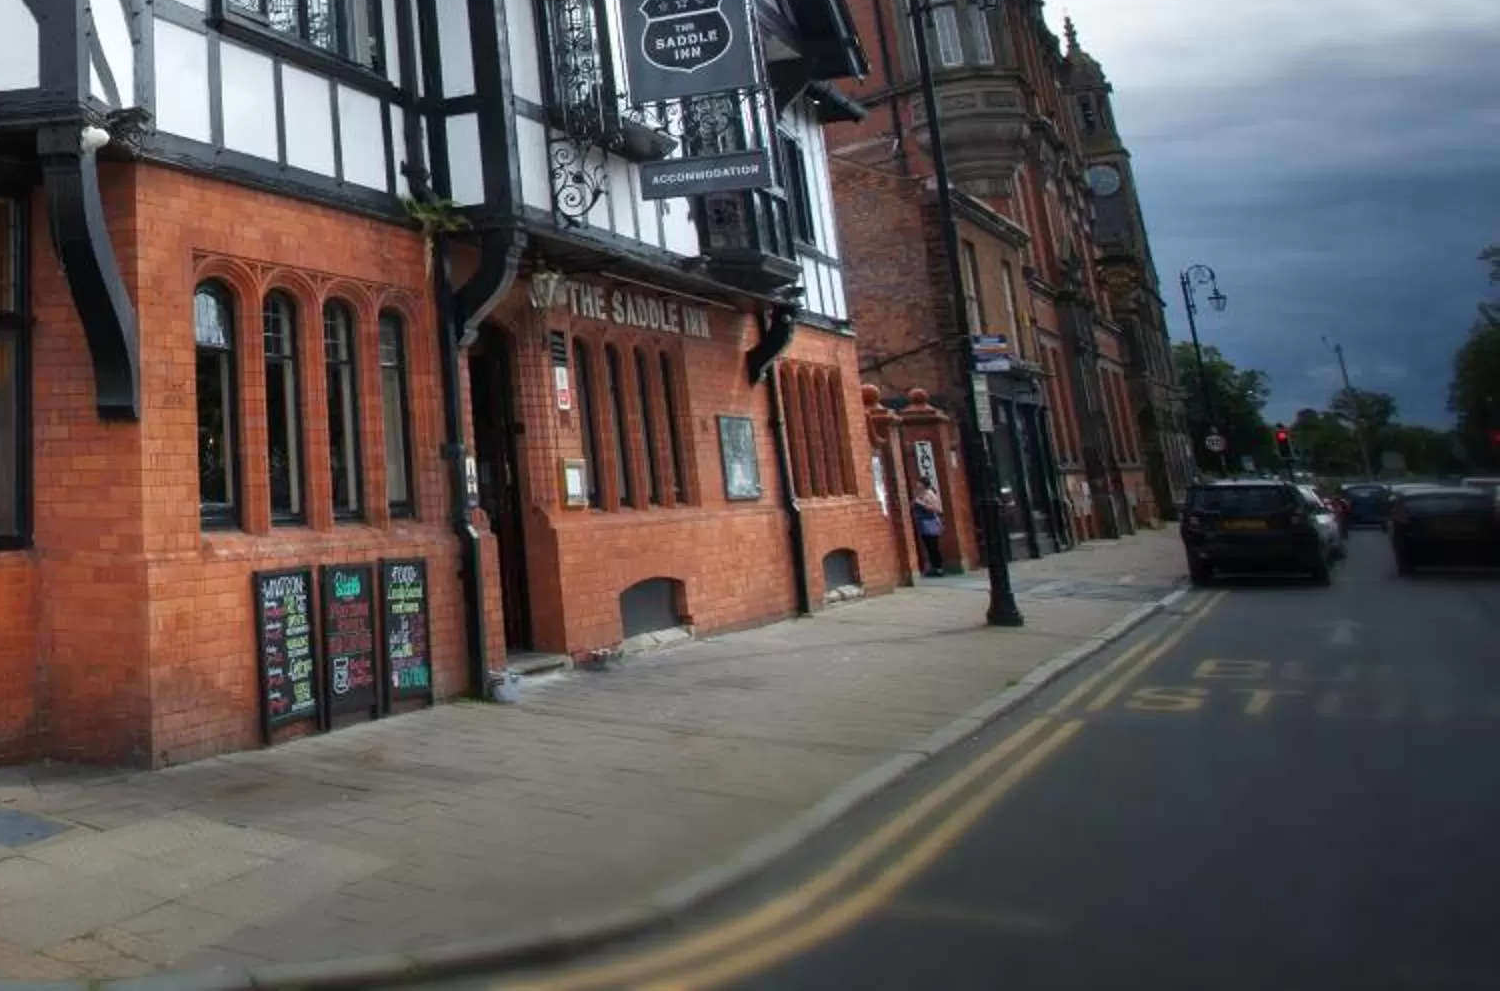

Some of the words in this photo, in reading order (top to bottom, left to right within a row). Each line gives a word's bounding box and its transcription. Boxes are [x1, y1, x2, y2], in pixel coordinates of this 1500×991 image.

[674, 22, 695, 34] THE
[655, 31, 720, 51] SADDLE
[674, 46, 702, 60] INN
[651, 163, 760, 185] ACCOMMODATION
[569, 282, 607, 320] THE
[611, 289, 680, 334] SADDLE
[683, 305, 710, 338] INN
